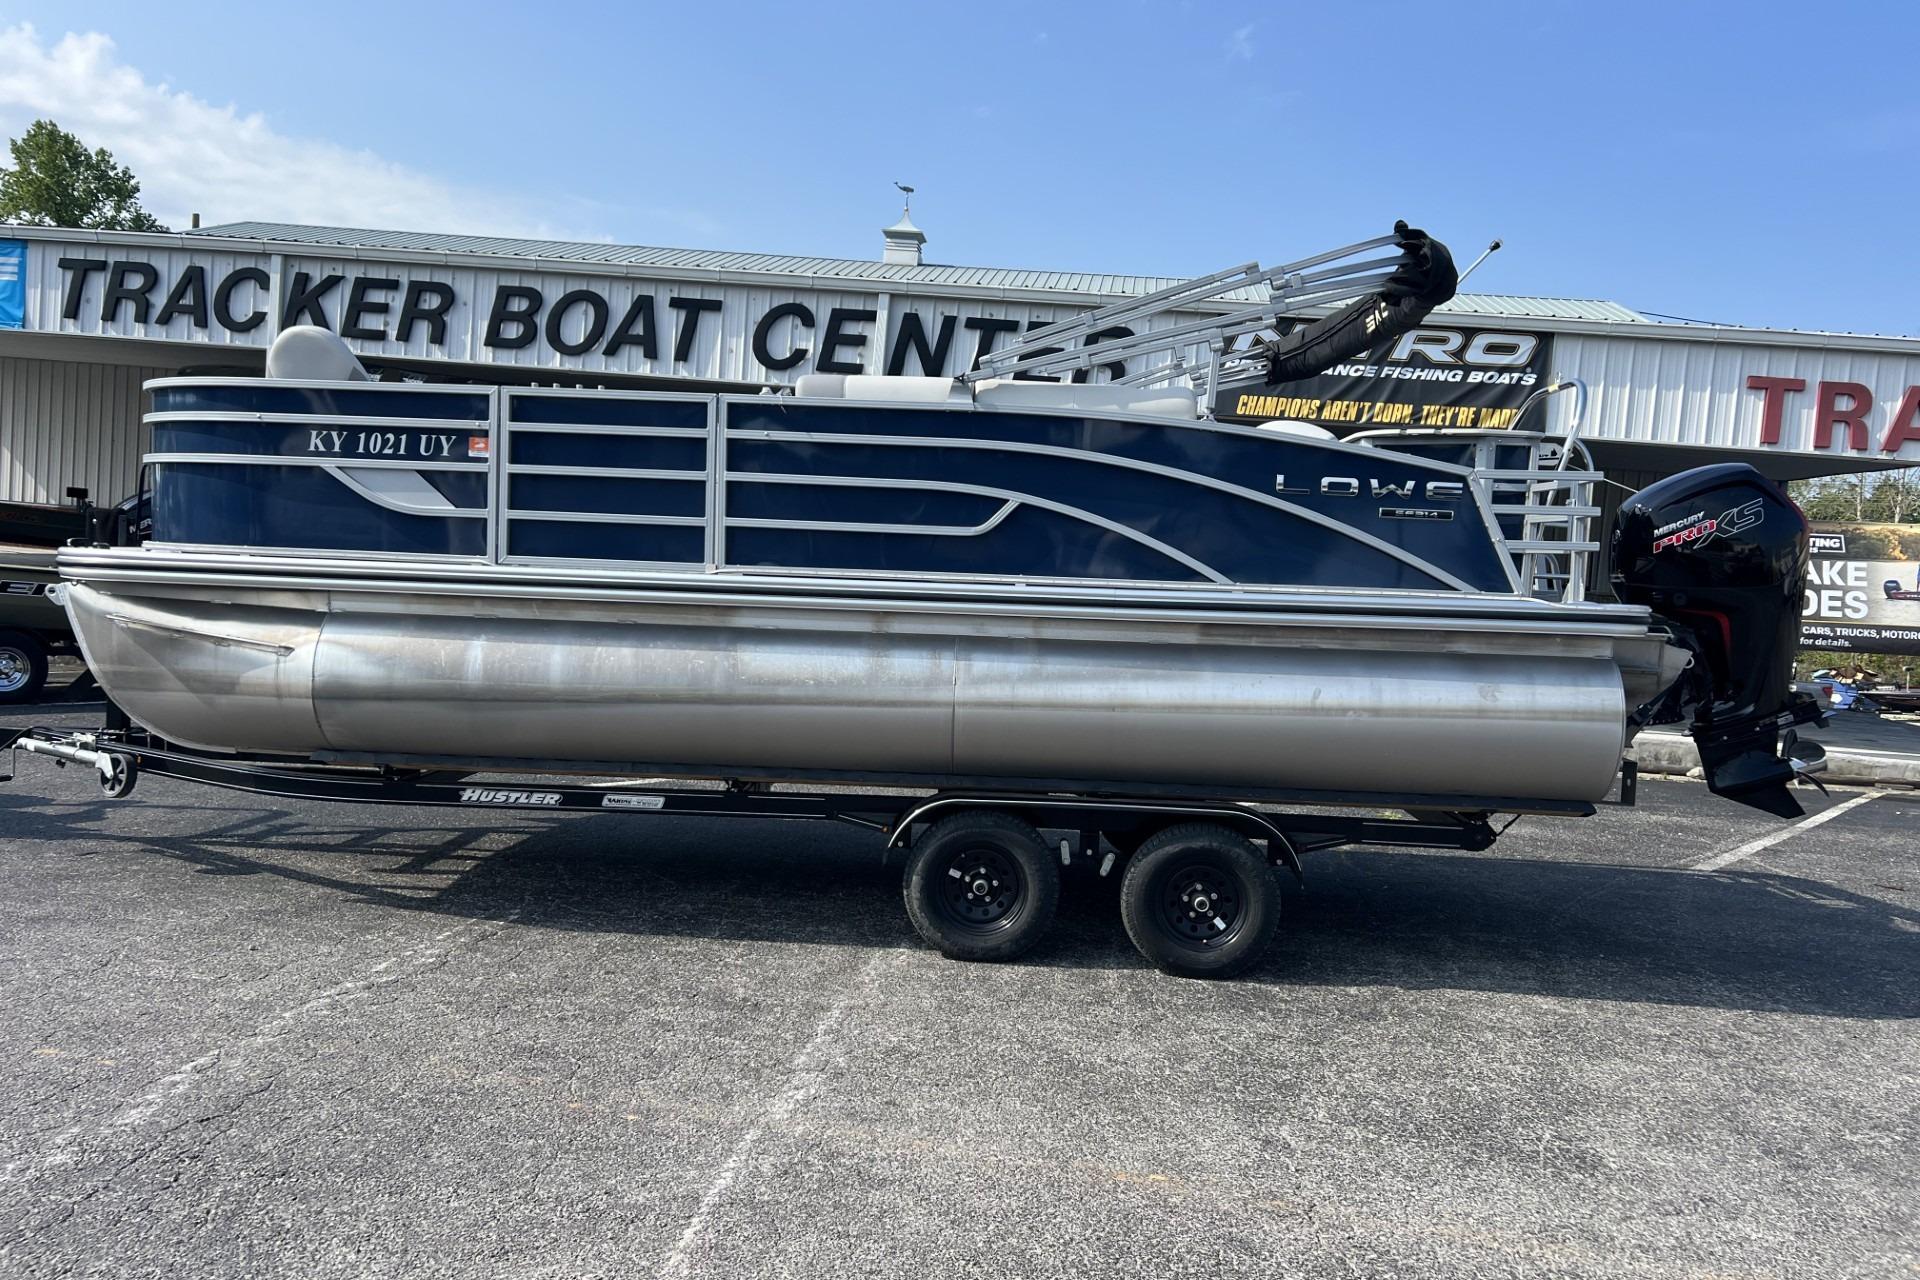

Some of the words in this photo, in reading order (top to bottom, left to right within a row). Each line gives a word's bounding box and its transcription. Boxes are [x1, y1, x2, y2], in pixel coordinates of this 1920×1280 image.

[57, 257, 456, 345] TRACKER
[484, 284, 722, 362] BOAT
[1380, 366, 1462, 384] FISHING
[1467, 371, 1538, 386] BOATS
[1236, 394, 1320, 419] CHAMPIONS
[1321, 400, 1371, 423] AREN'T
[1420, 404, 1476, 427] THEY'RE
[308, 430, 348, 452] KY
[355, 432, 408, 455] 1021
[419, 434, 457, 457] UY
[1275, 474, 1464, 500] LOWE
[1653, 510, 1705, 538] MERCURY
[1809, 537, 1840, 548] TING
[1807, 560, 1868, 587] AKE
[1800, 636, 1814, 645] for
[1815, 637, 1852, 648] details.
[1802, 626, 1834, 637] CARS,
[1835, 627, 1880, 639] TRUCKS,
[1881, 630, 1920, 640] MOTOR
[460, 788, 561, 805] HUSTLER
